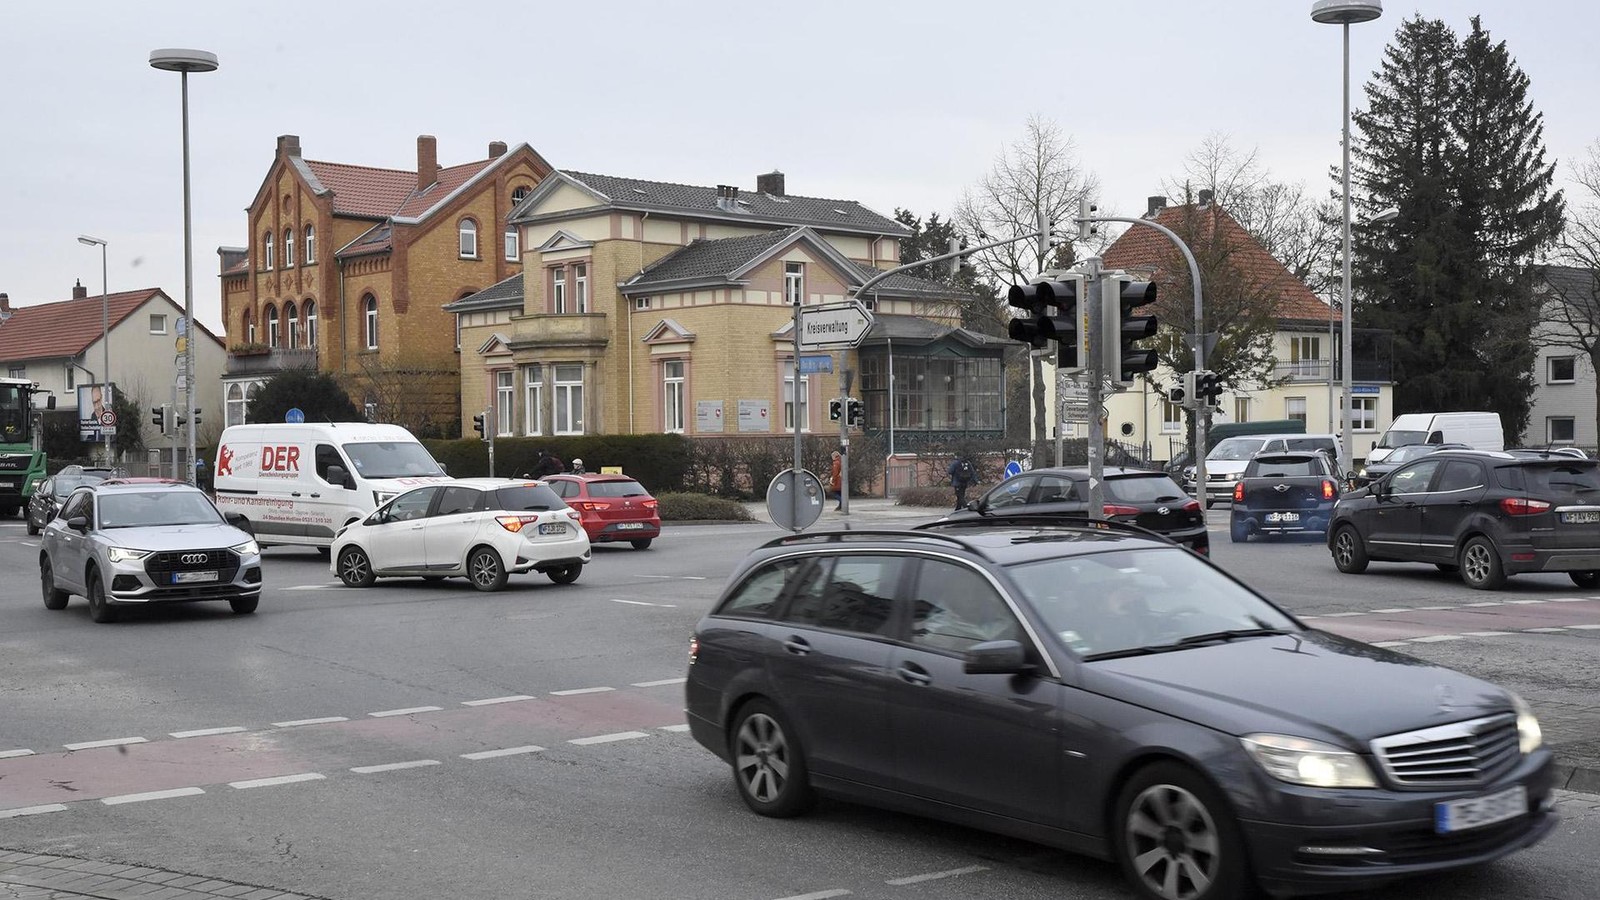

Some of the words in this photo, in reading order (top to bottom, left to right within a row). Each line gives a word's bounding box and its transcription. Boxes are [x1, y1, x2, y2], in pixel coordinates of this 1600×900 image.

[807, 320, 848, 334] Kreisverwaltung
[103, 414, 112, 422] 30
[261, 446, 300, 472] DER
[217, 495, 234, 504] Rohr-
[234, 496, 245, 504] und
[246, 497, 294, 509] Kanalreinigung
